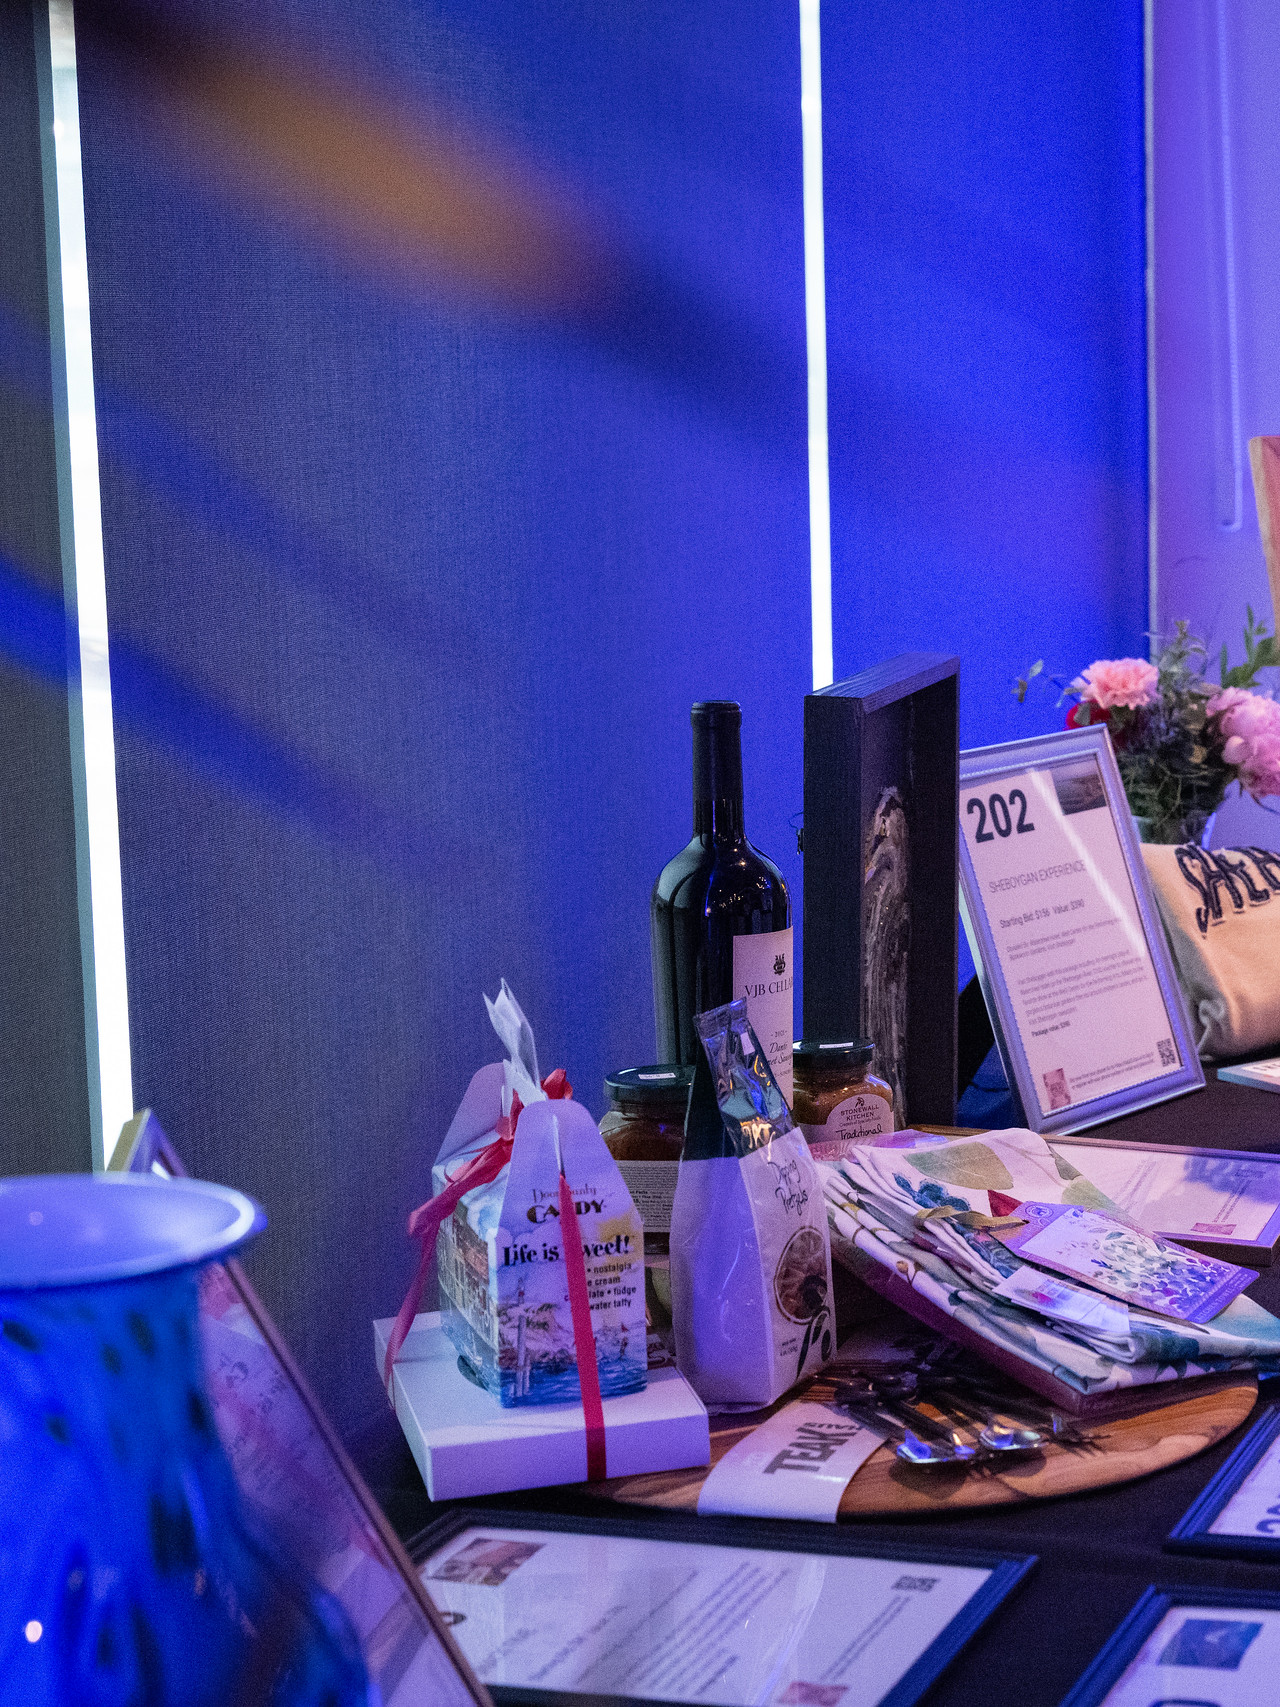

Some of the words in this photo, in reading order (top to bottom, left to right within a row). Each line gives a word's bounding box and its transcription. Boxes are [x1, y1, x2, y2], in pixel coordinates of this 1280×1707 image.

[967, 789, 1035, 844] 202
[988, 871, 1037, 894] SHEBOYGAN
[1037, 859, 1086, 883] EXPERIENCE
[1000, 915, 1023, 931] Starting
[744, 983, 766, 999] VJB
[840, 1104, 880, 1117] STONEWALL
[846, 1112, 875, 1122] KITCHEN
[836, 1124, 883, 1140] Traditional
[527, 1199, 604, 1224] CADY
[502, 1243, 538, 1267] Life
[542, 1243, 559, 1262] is
[582, 1235, 630, 1259] weet!
[594, 1263, 632, 1275] nostalgia
[595, 1276, 621, 1286] cream
[613, 1286, 637, 1297] fudge
[613, 1298, 632, 1309] taffy
[762, 1427, 857, 1474] TEAK
